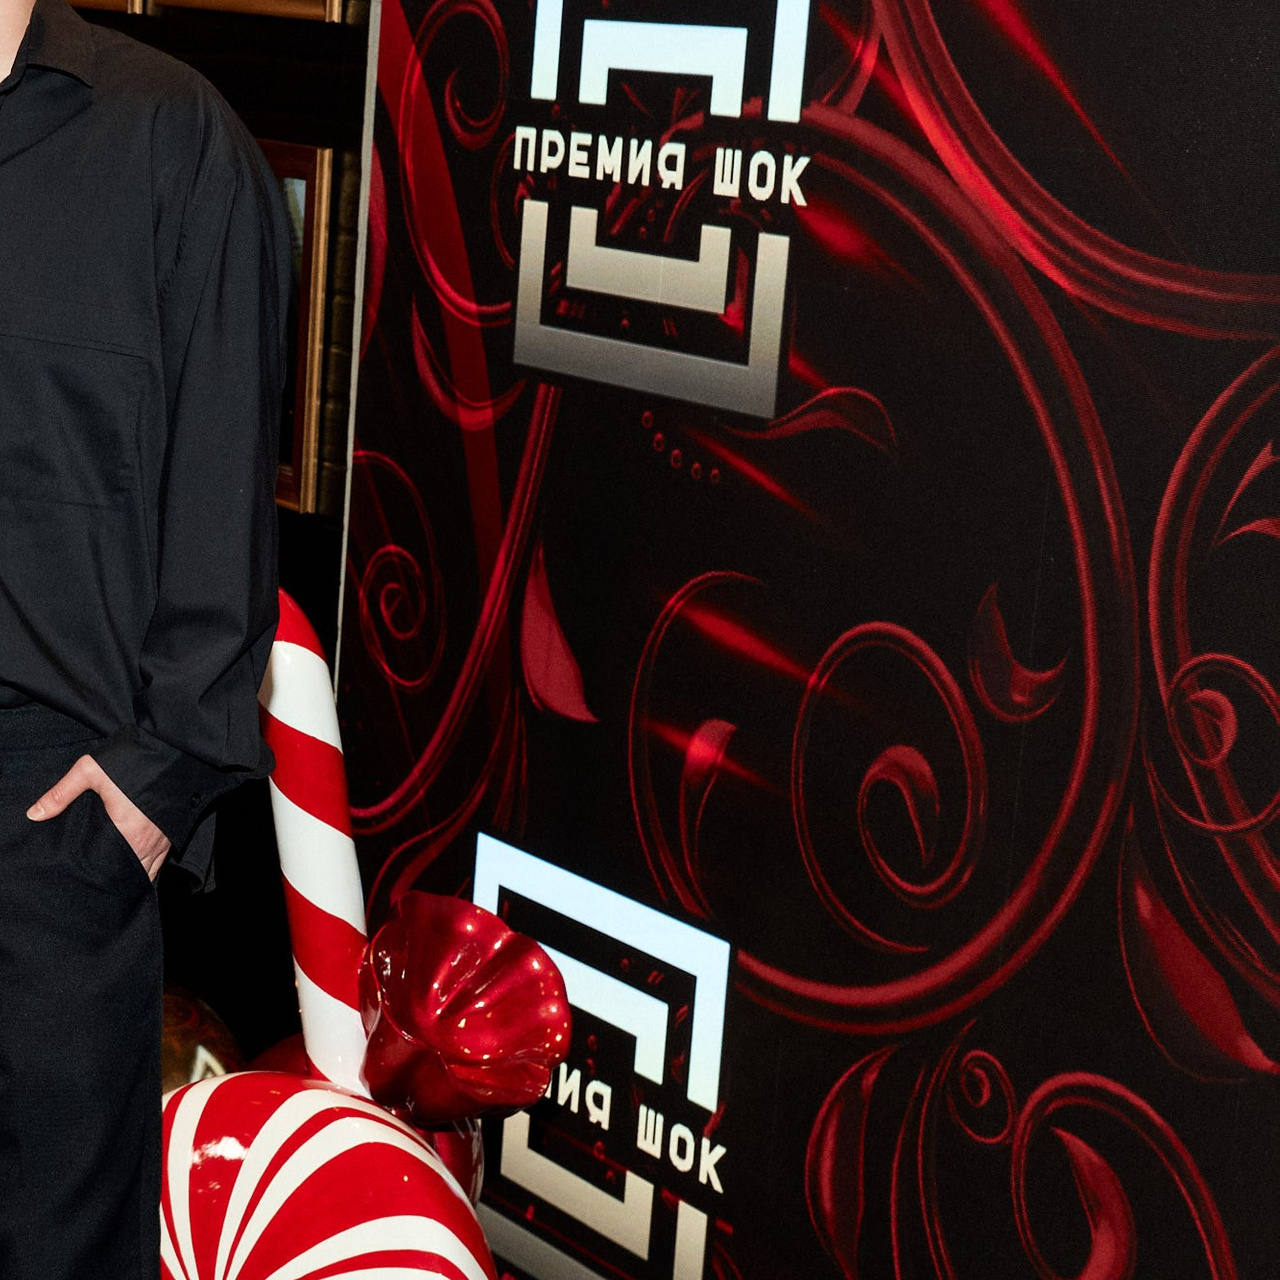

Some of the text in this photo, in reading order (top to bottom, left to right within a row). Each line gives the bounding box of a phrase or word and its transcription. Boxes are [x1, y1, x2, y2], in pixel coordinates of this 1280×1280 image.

[513, 125, 811, 207] ПРЕМИЯ ШОК
[636, 1103, 727, 1194] ШОК
